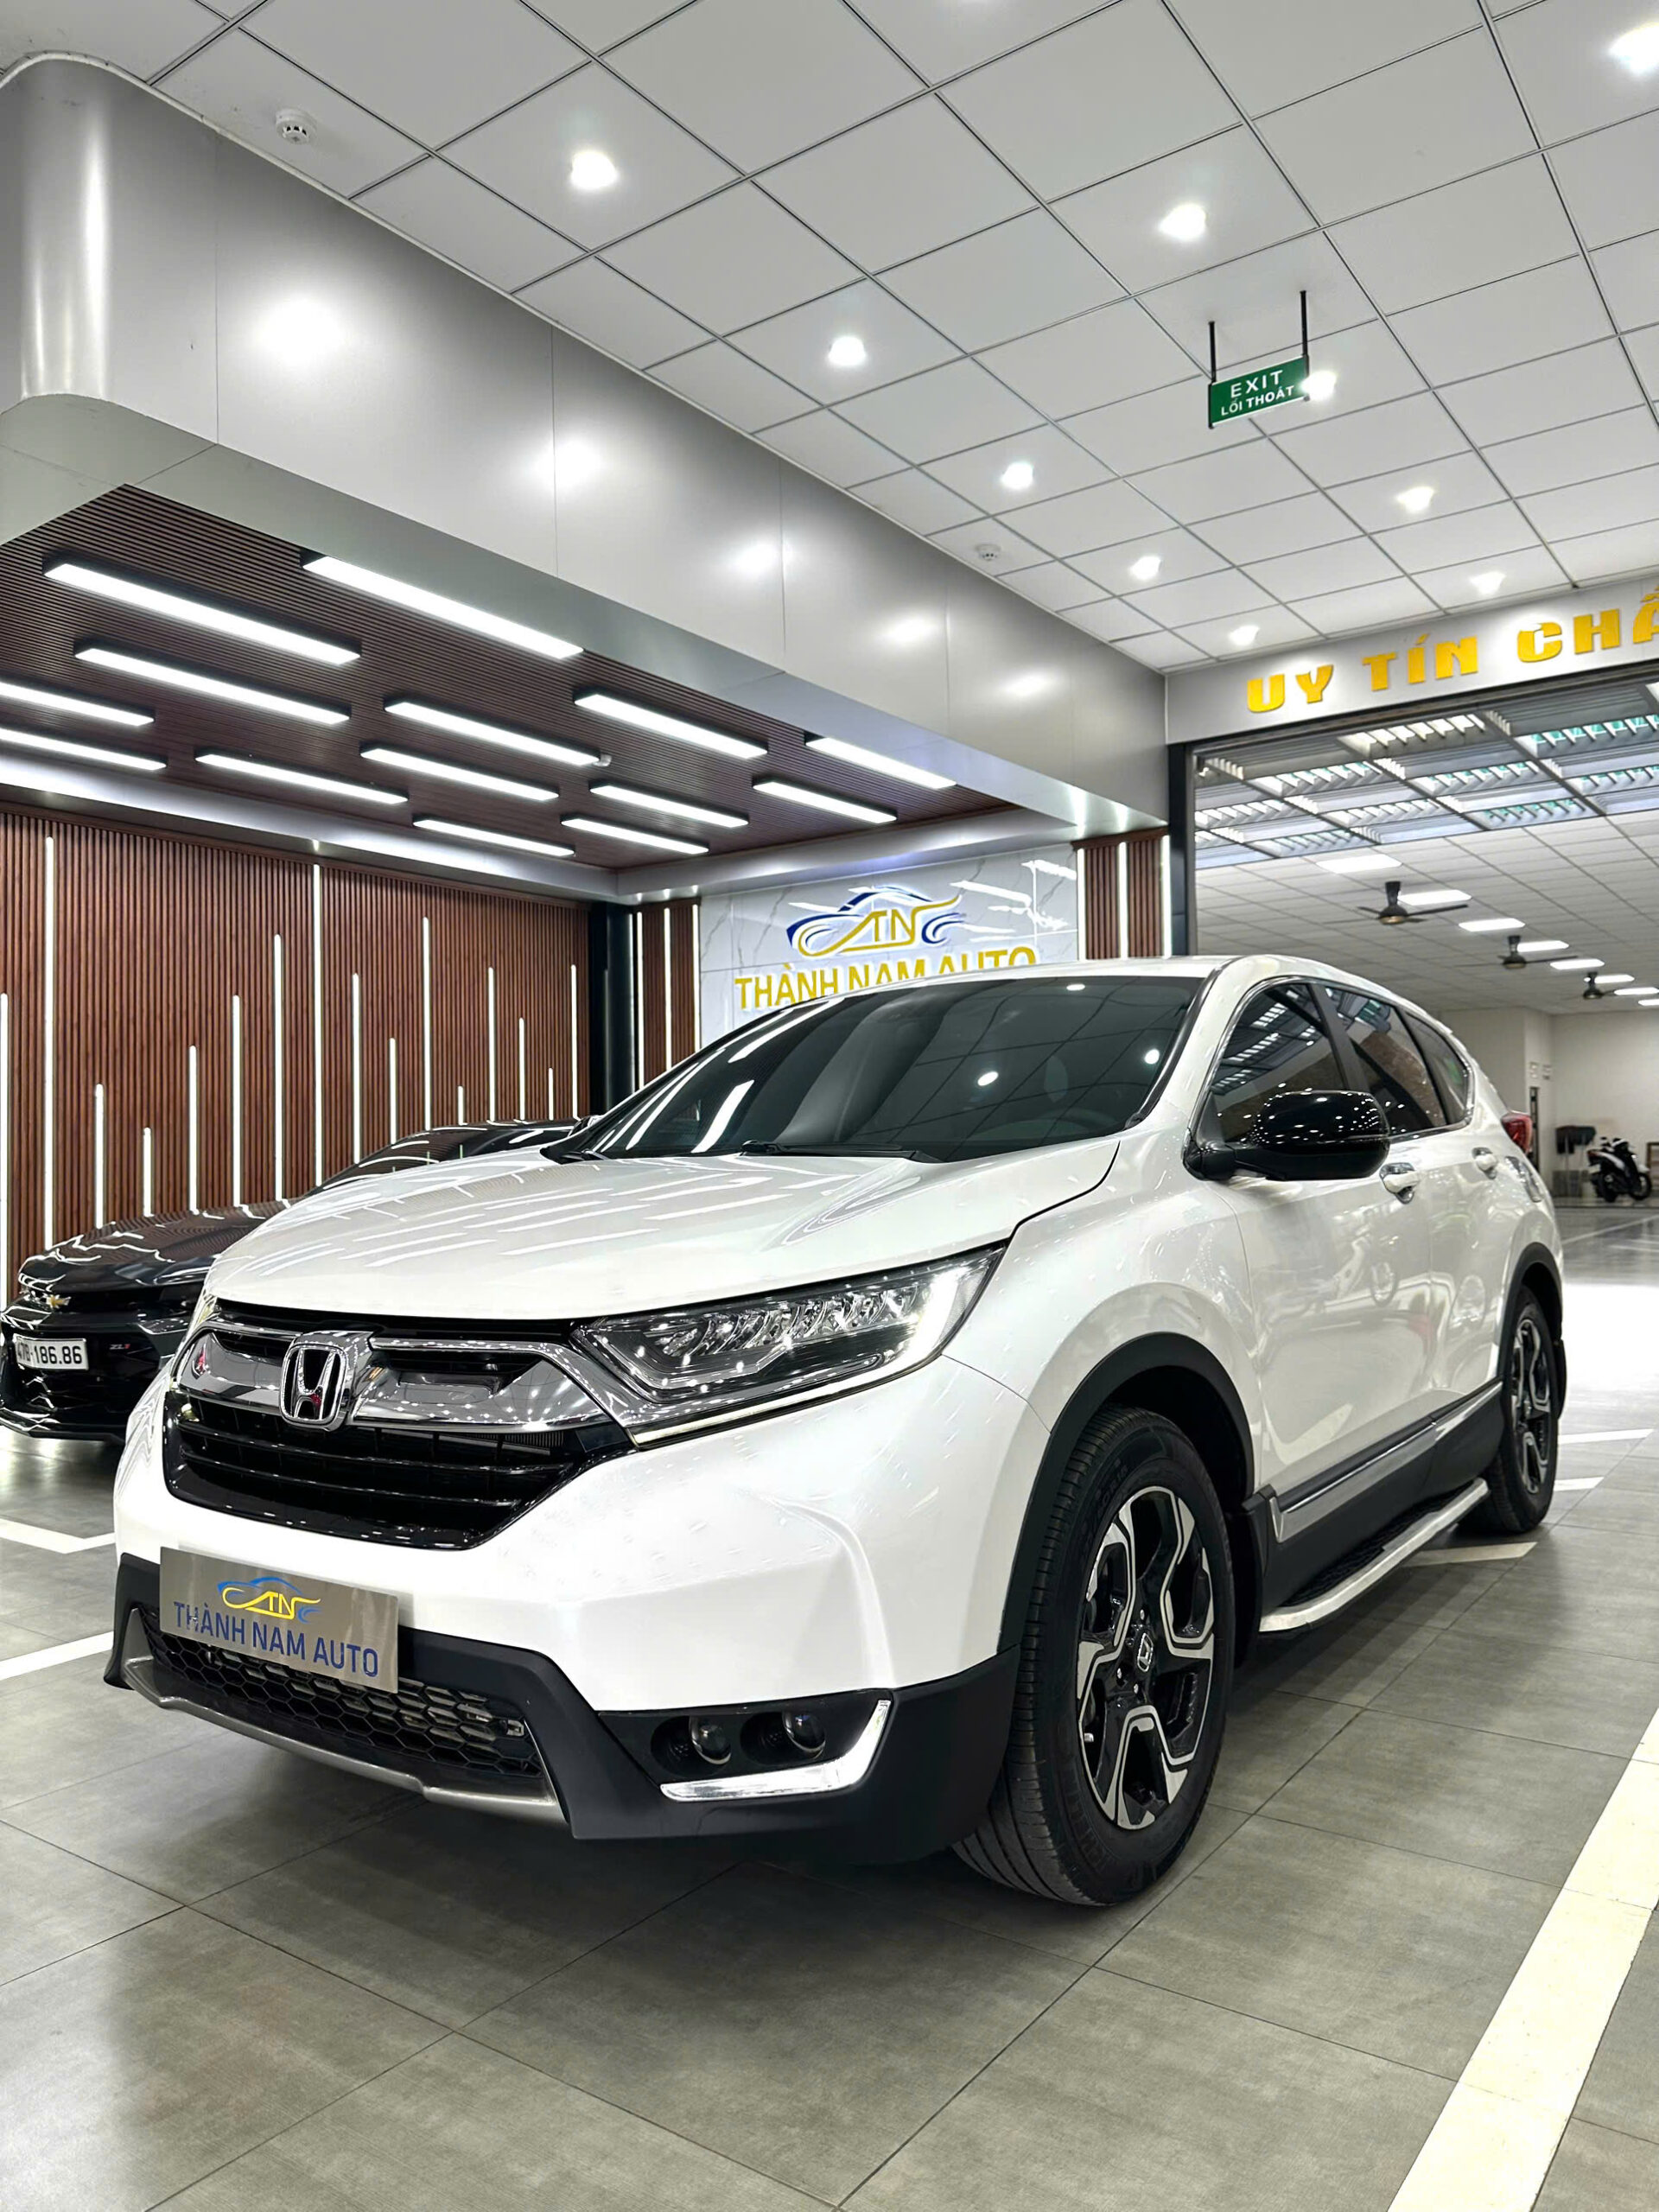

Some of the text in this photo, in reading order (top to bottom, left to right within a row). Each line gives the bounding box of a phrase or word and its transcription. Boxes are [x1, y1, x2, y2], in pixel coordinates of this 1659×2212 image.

[1230, 370, 1283, 398] EXIT
[1246, 385, 1294, 409] THOÁT
[1247, 664, 1333, 714] UY
[1362, 633, 1478, 691] TÍN
[735, 962, 838, 1009] THÀNH
[849, 958, 925, 990] NAM
[174, 1601, 378, 1677] THÀNH NAM AUTO
